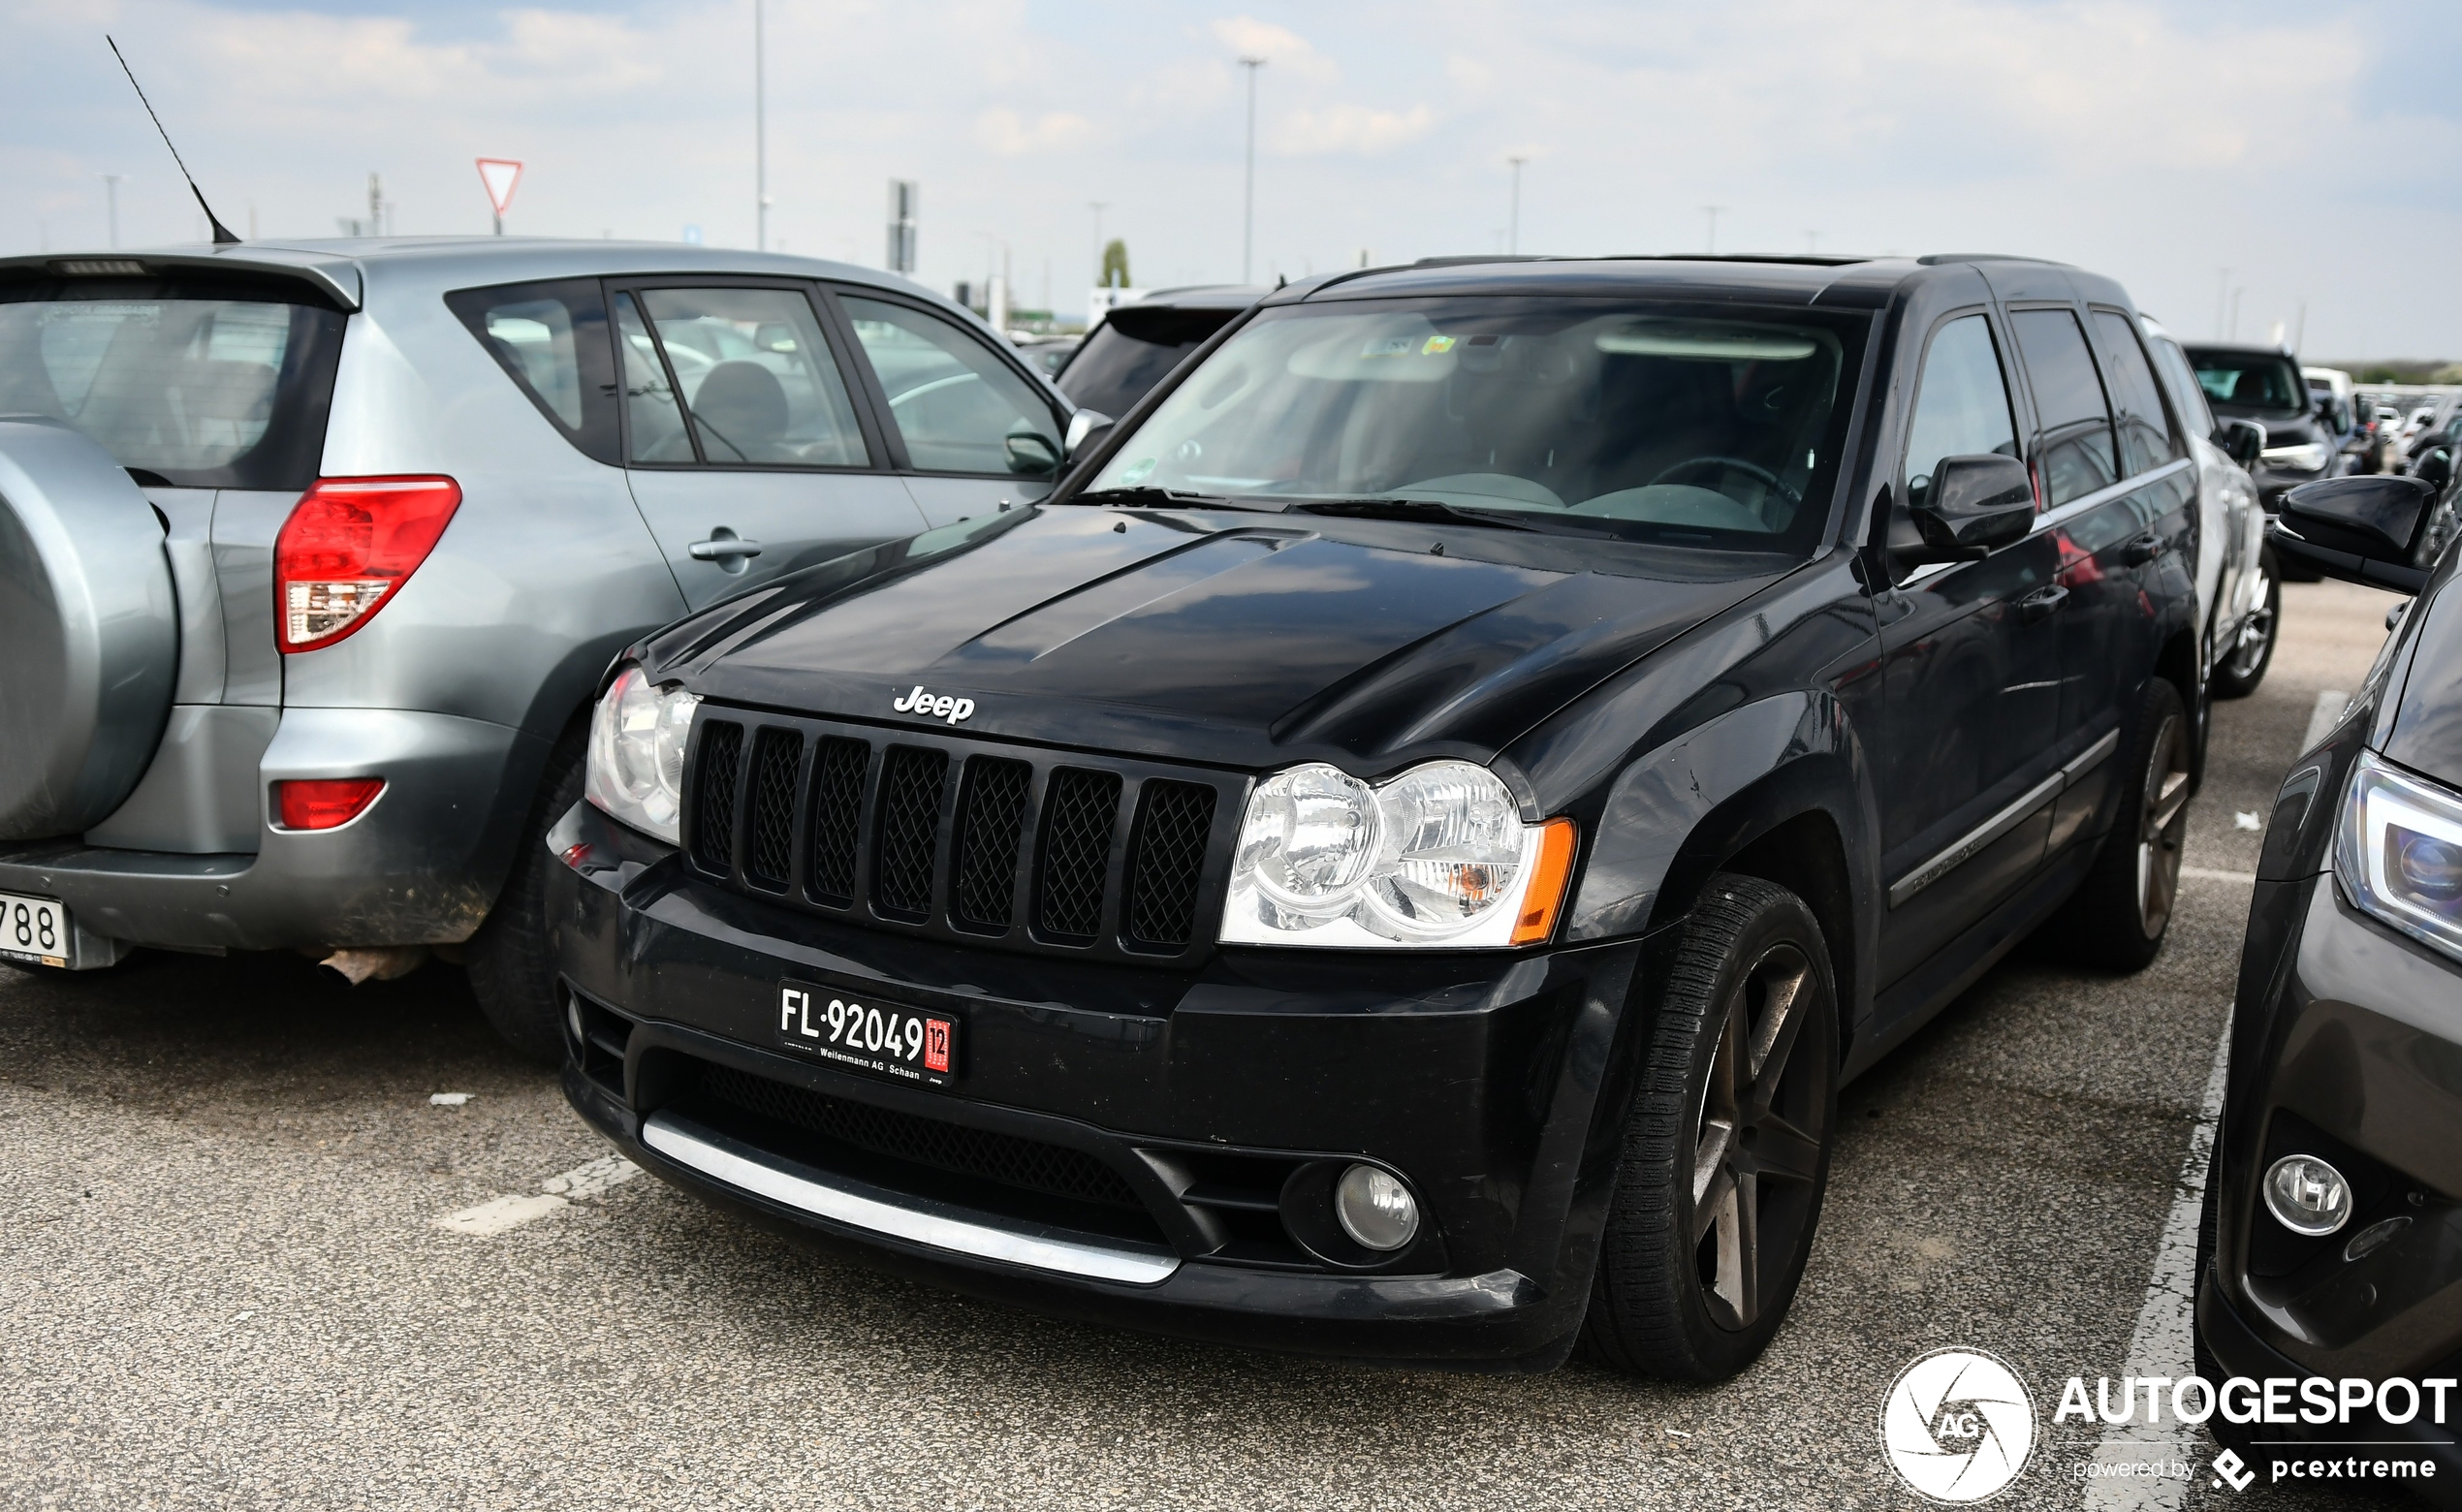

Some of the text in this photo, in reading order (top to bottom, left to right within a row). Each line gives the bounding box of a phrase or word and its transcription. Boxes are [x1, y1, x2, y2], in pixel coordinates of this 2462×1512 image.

[894, 685, 974, 725] Jeep
[930, 1027, 946, 1055] 12
[820, 1048, 920, 1080] Weilenmann AG Schaan
